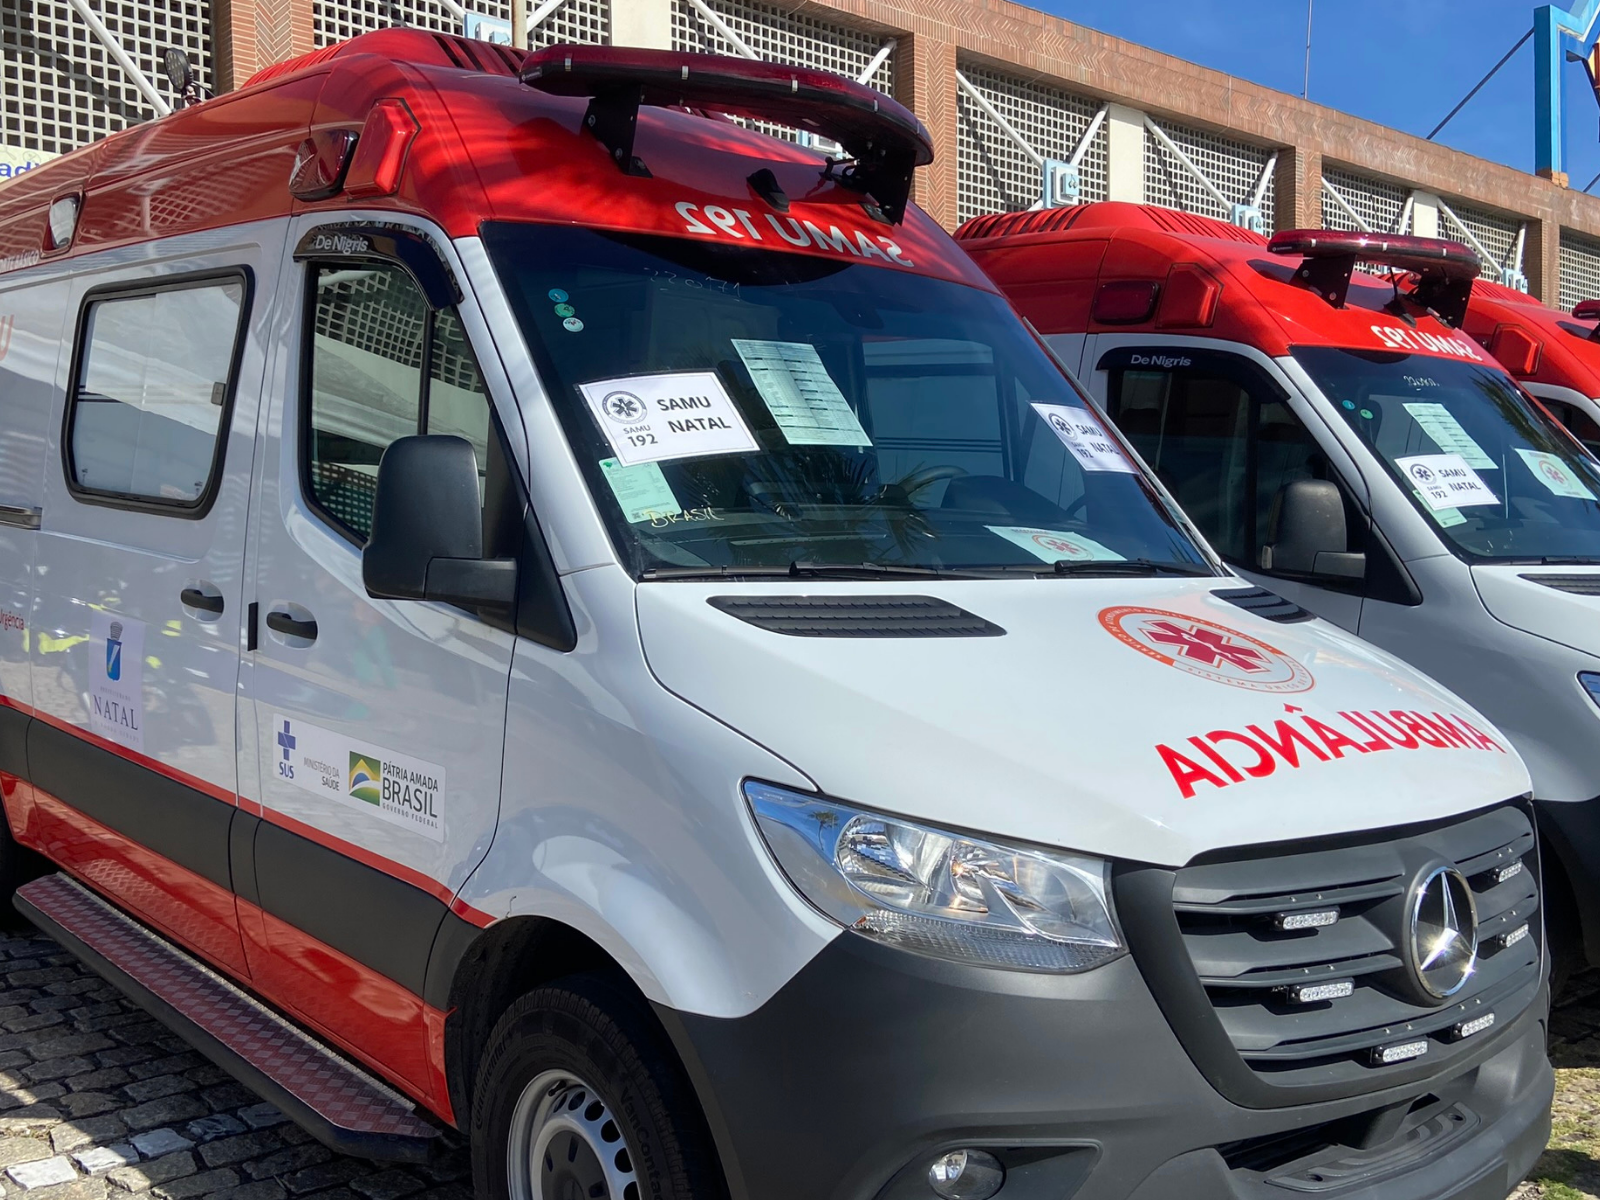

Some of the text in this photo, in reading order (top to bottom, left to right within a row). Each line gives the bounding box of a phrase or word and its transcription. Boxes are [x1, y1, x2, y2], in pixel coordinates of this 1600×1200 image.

[0, 161, 40, 178] ad
[315, 235, 369, 255] De Nigris
[1130, 354, 1192, 368] De Nigris
[657, 396, 712, 412] SAMU
[623, 424, 651, 435] SAMU
[667, 416, 732, 433] NATAL
[1075, 424, 1103, 437] SAMU
[627, 433, 658, 447] 192
[1077, 448, 1094, 459] 192
[1089, 441, 1121, 456] NATAL
[1438, 468, 1467, 478] SAMU
[1431, 490, 1448, 499] 192
[1448, 481, 1482, 492] NATAL
[93, 694, 139, 731] NATAL
[279, 761, 294, 779] SUS
[303, 756, 340, 779] MINISTÉRIO DA
[321, 775, 340, 791] SAÚDE
[383, 761, 438, 793] PÁTRIA AMADA
[382, 776, 438, 819] BRASIL
[382, 802, 438, 830] GOVERNO FEDERAL
